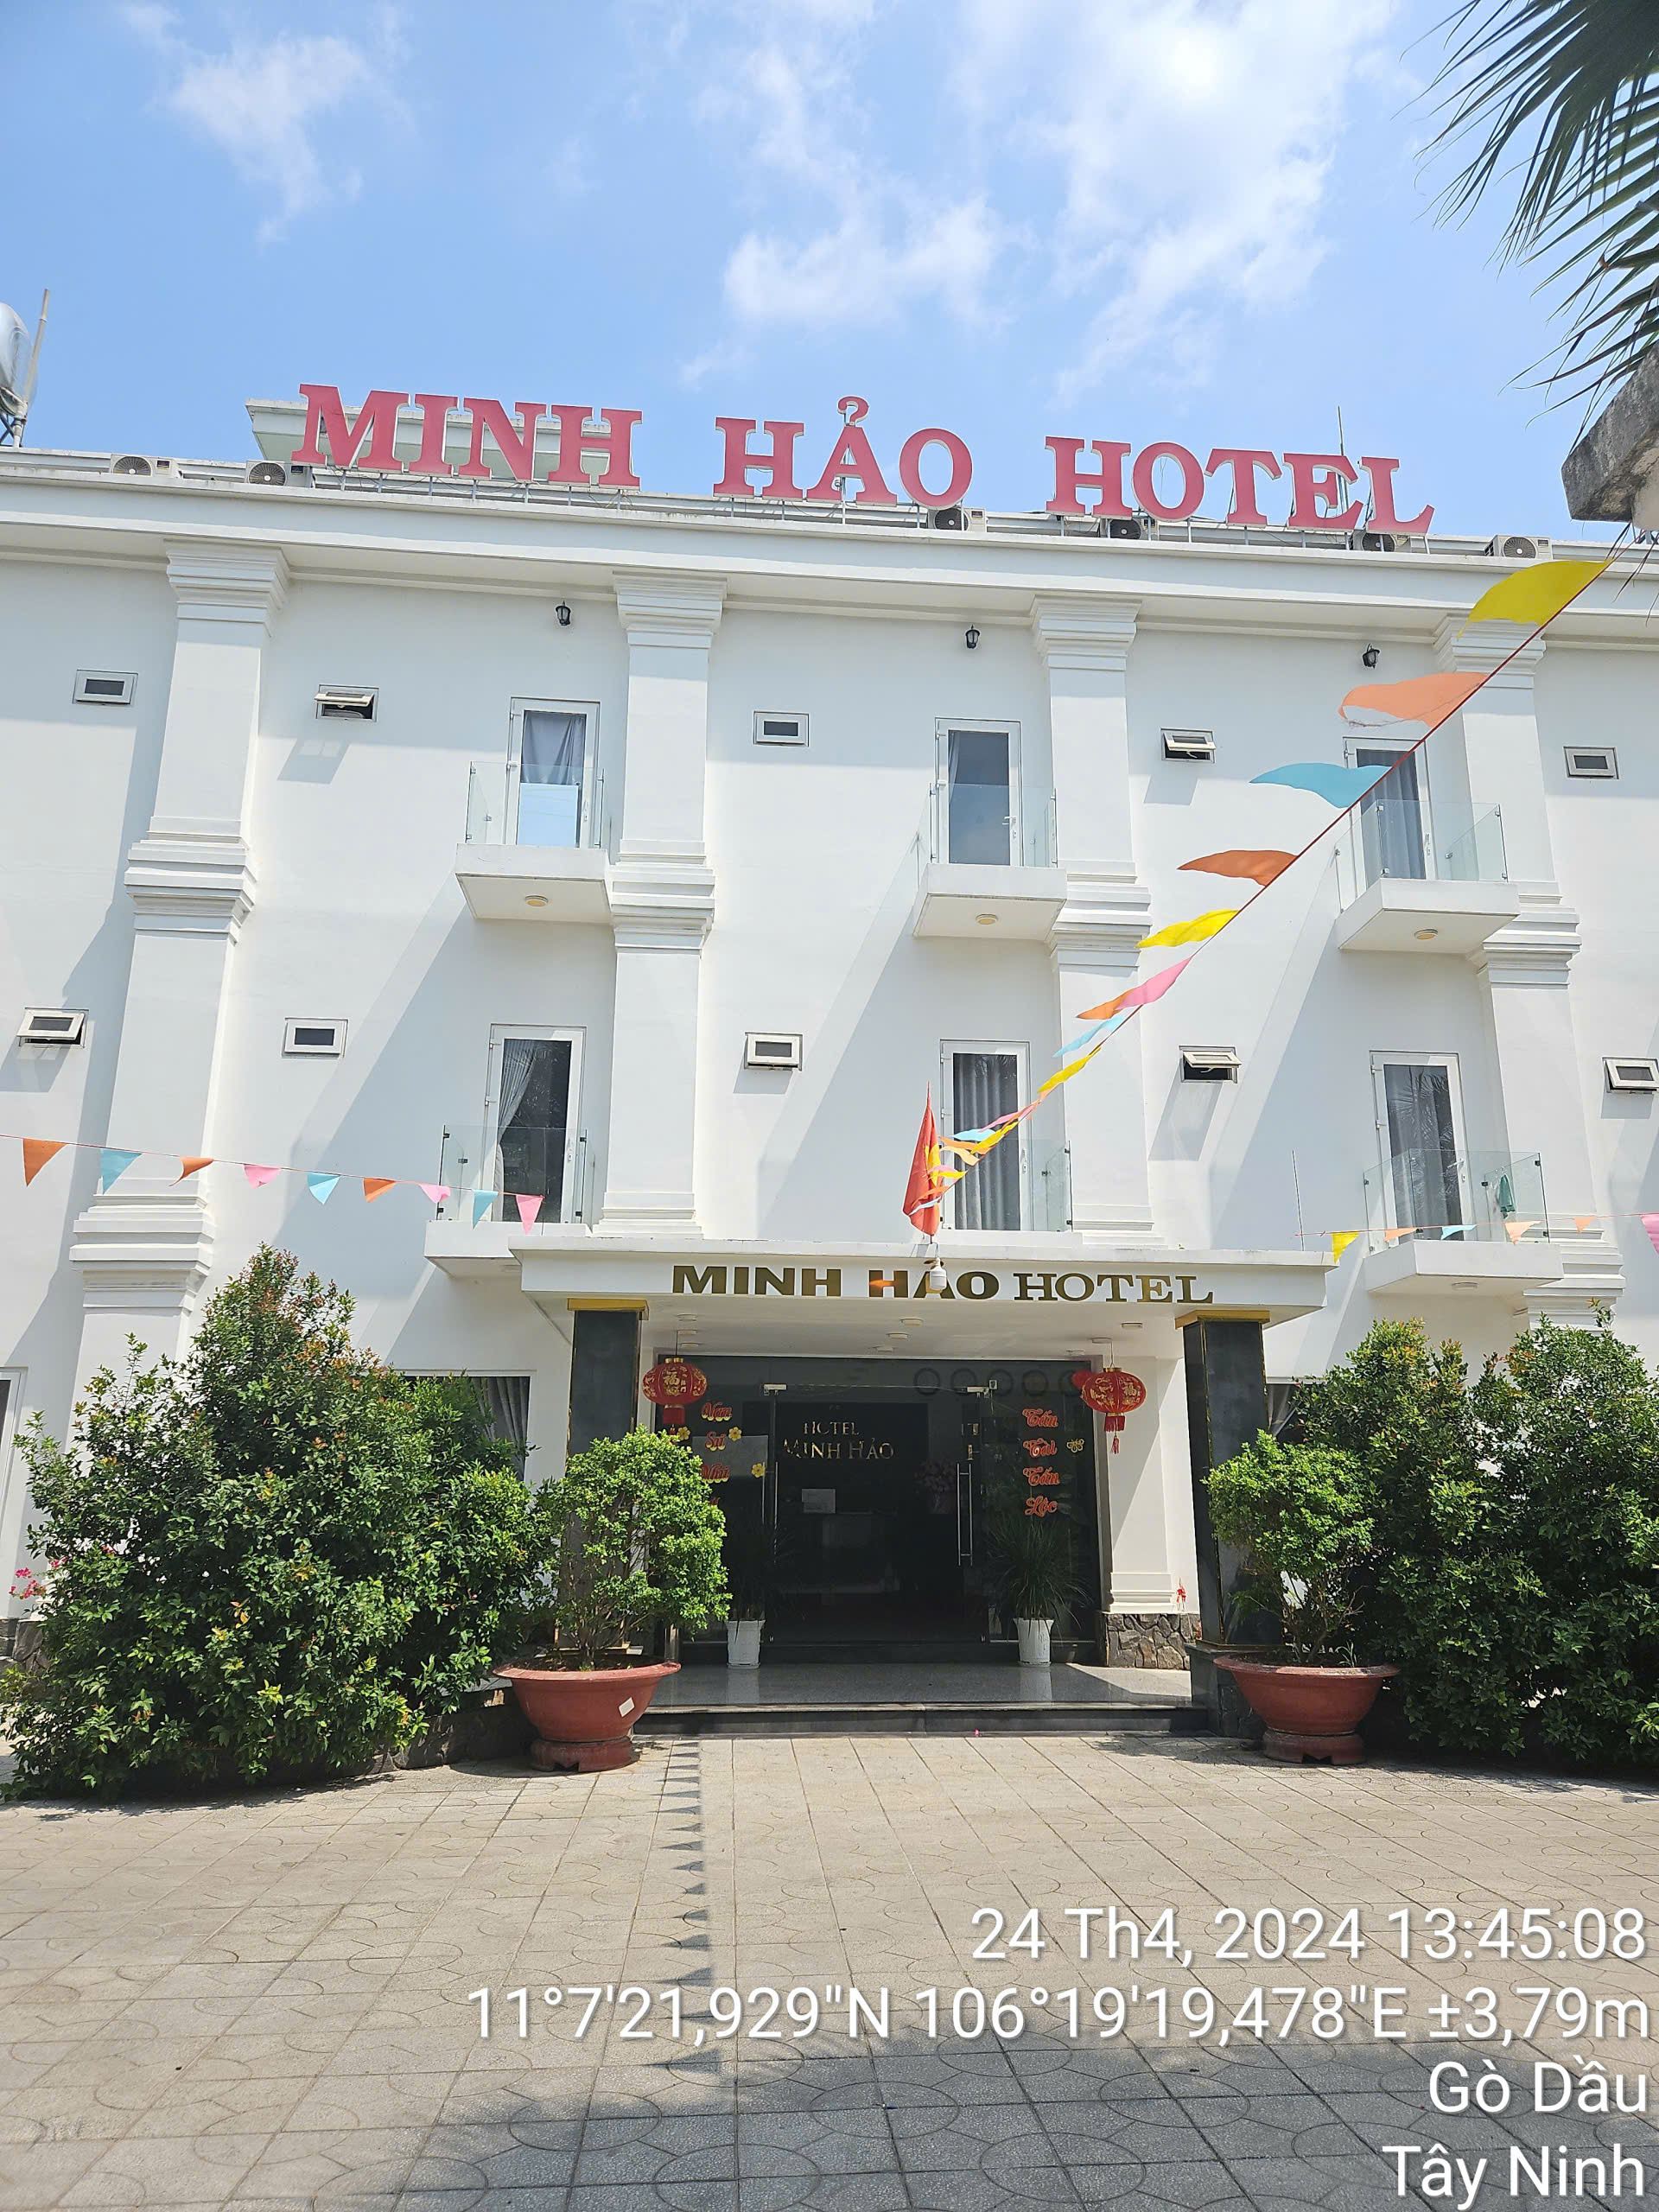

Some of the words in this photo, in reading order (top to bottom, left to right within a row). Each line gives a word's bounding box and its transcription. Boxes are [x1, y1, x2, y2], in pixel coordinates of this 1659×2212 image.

[291, 384, 643, 491] MINH
[713, 396, 972, 510] HẢO
[1045, 435, 1435, 535] HOTEL
[672, 1265, 842, 1297] MINH
[1013, 1273, 1214, 1304] HOTEL
[804, 1421, 860, 1435] HOTEL
[848, 1437, 894, 1459] HẢO
